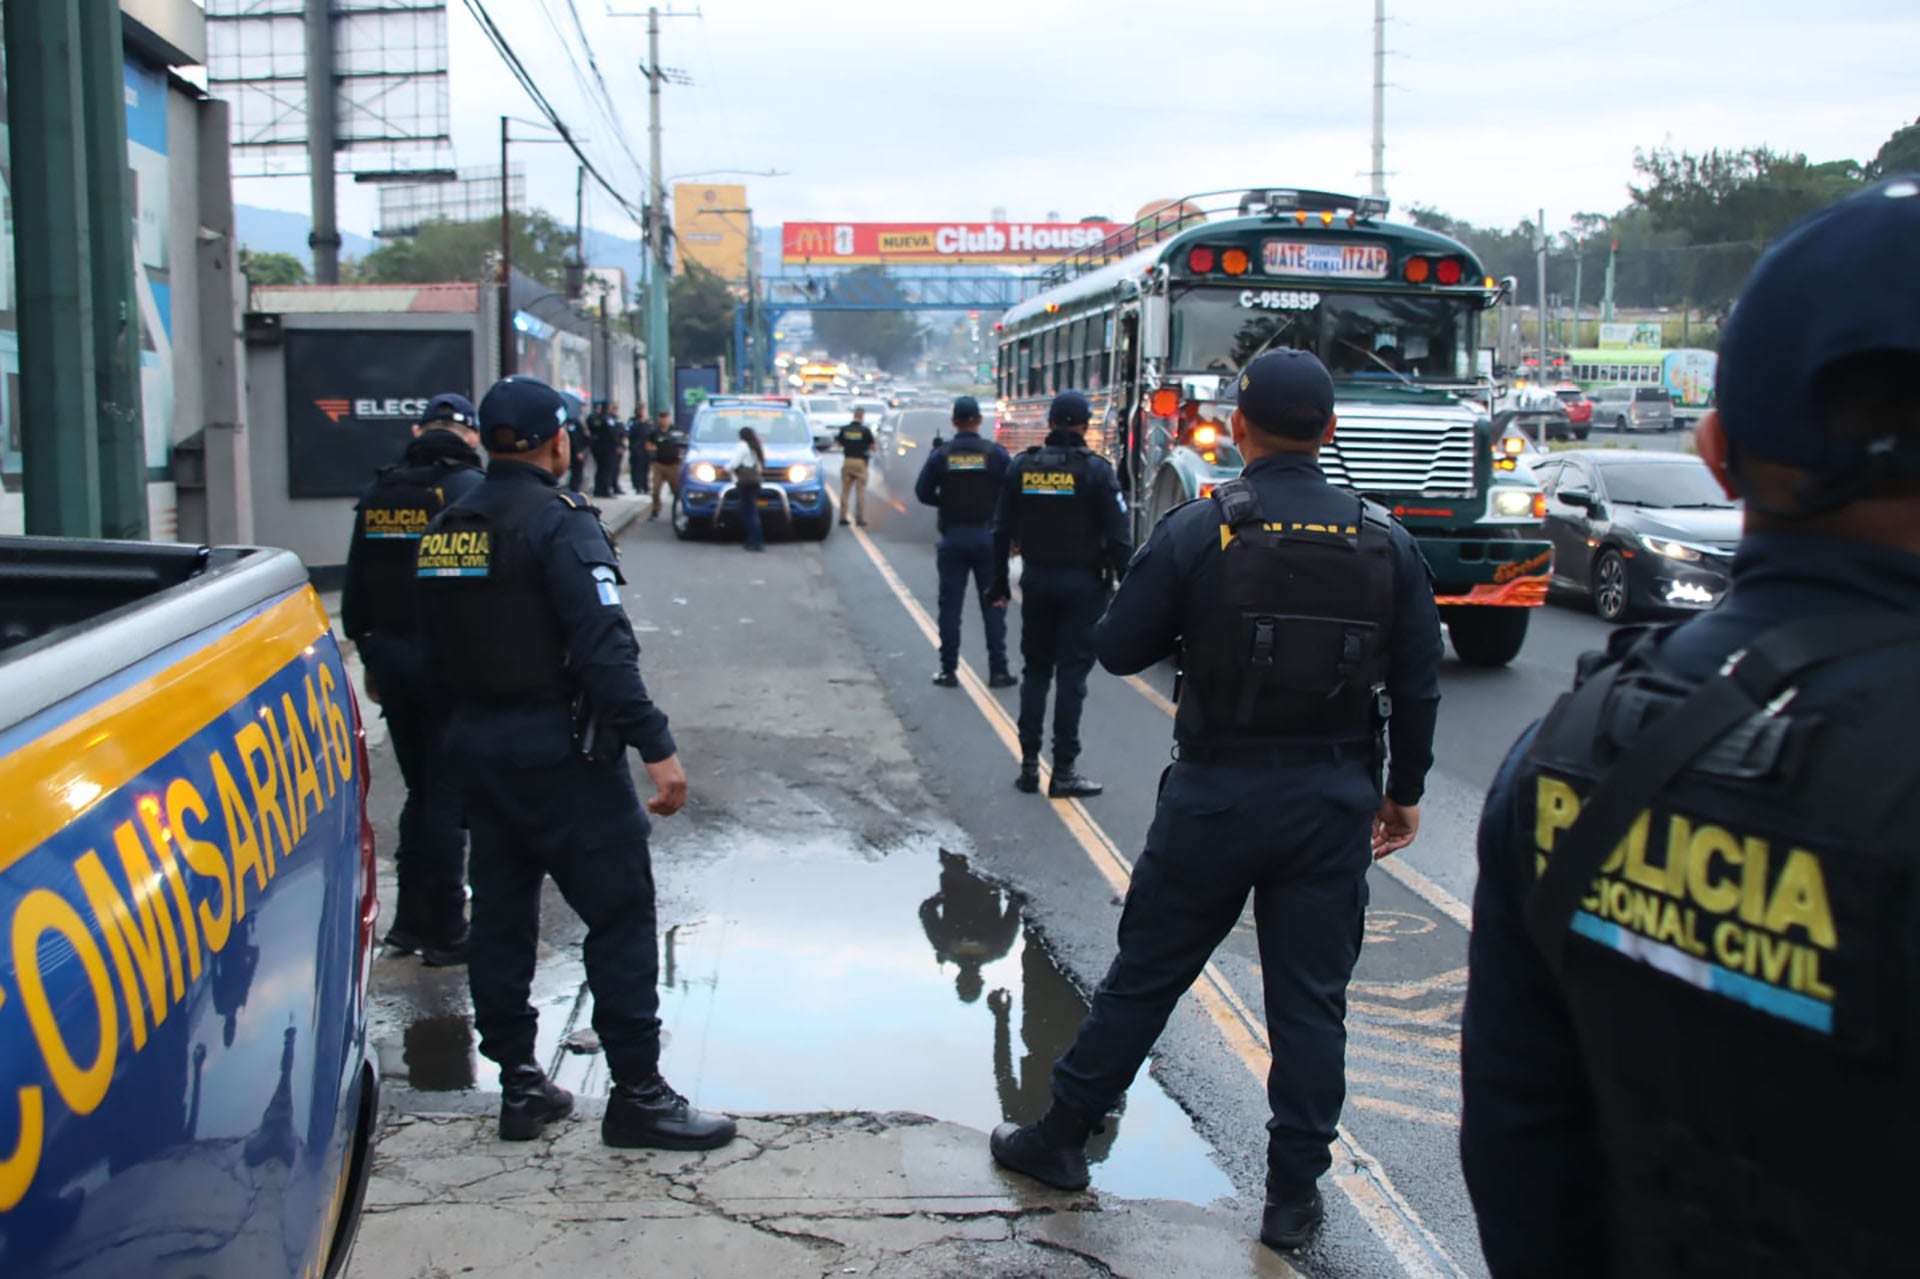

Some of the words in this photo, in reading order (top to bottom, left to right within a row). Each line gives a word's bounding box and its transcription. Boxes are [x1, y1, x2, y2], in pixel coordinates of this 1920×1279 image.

[883, 235, 931, 248] NUEVA
[936, 227, 1005, 253] Club
[1010, 225, 1104, 251] House
[1343, 246, 1389, 272] ITZAP
[1240, 291, 1320, 309] C-955BSP
[1022, 473, 1075, 485] POLICIA
[365, 510, 428, 525] POLICIA
[419, 532, 490, 555] POLICIA
[1535, 775, 1838, 950] PLICIA
[1713, 920, 1836, 998] CIVIL
